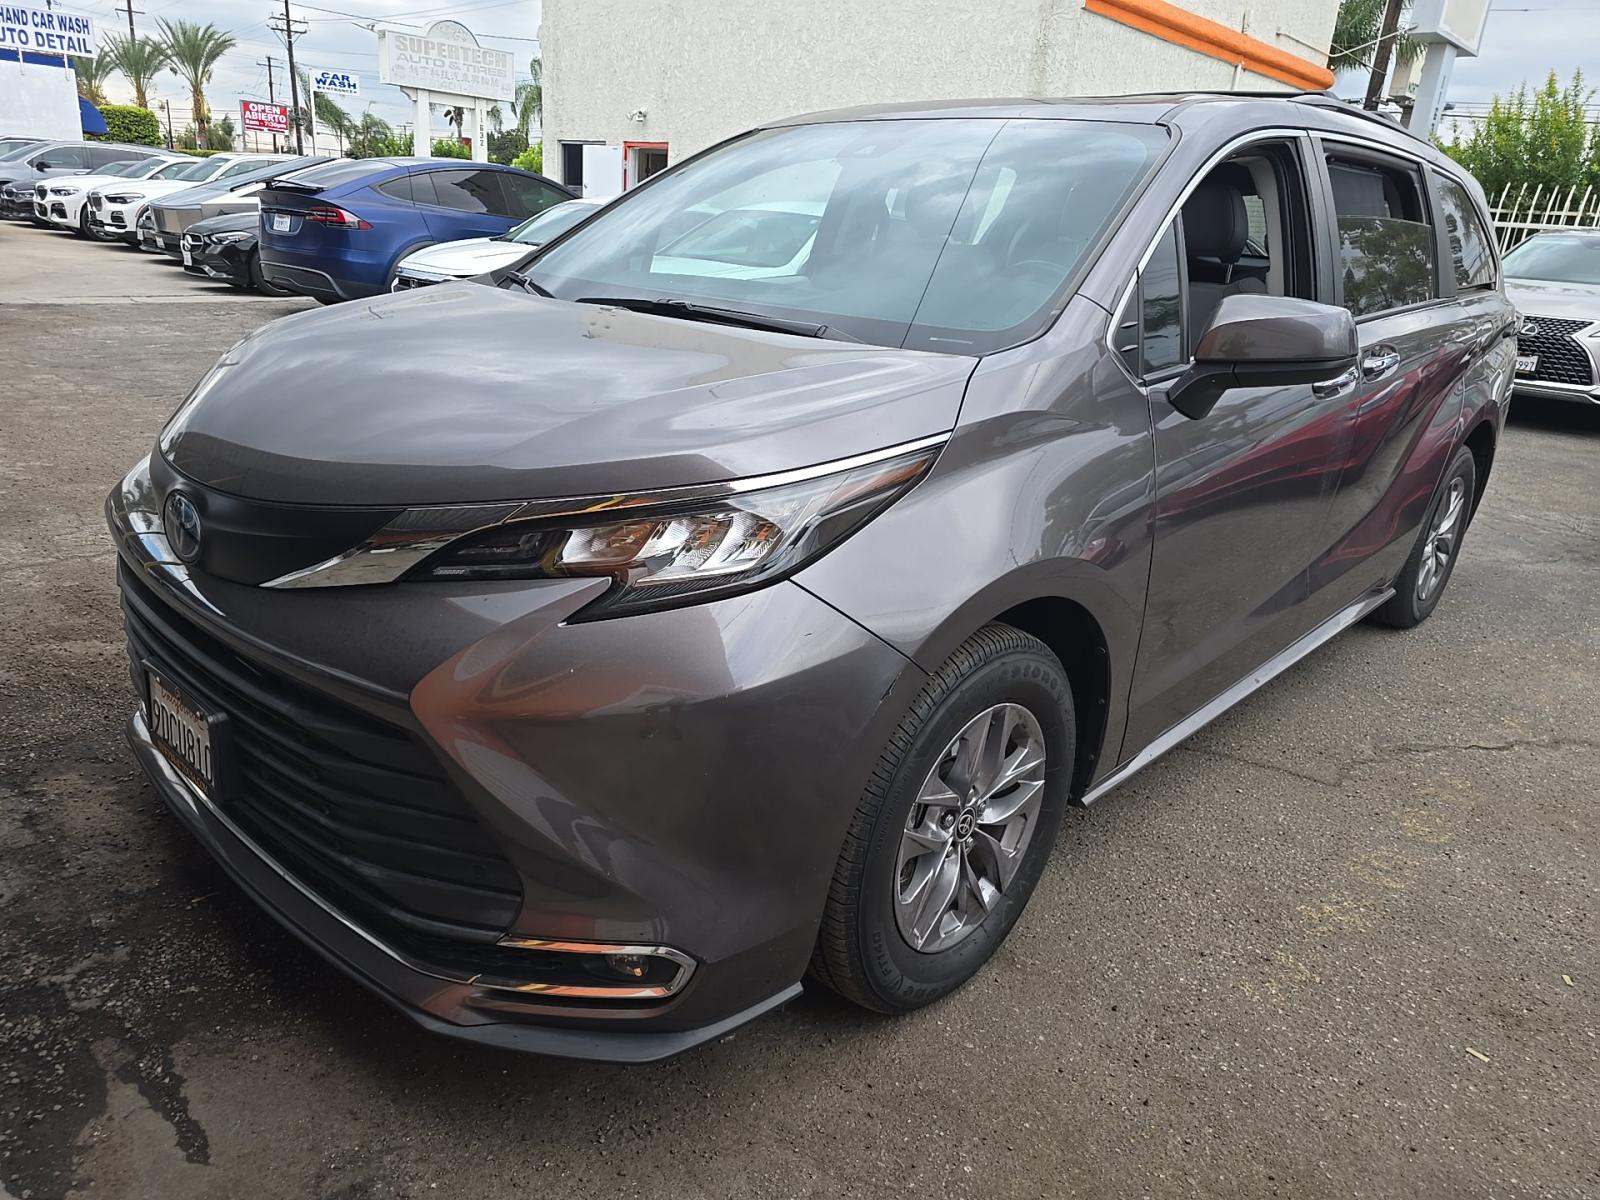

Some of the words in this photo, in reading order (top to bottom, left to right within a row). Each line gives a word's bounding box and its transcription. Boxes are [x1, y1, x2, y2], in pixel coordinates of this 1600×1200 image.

[32, 11, 55, 30] CAR
[57, 15, 90, 35] WASH
[0, 26, 29, 46] UTO
[35, 31, 92, 54] DETAIL
[394, 35, 507, 69] SUPERTECH
[396, 53, 446, 68] AUTO
[463, 63, 507, 78] TIRES
[315, 77, 357, 89] WASH
[321, 72, 350, 82] CAR
[244, 111, 287, 124] ABIERTO
[249, 103, 281, 115] OPEN
